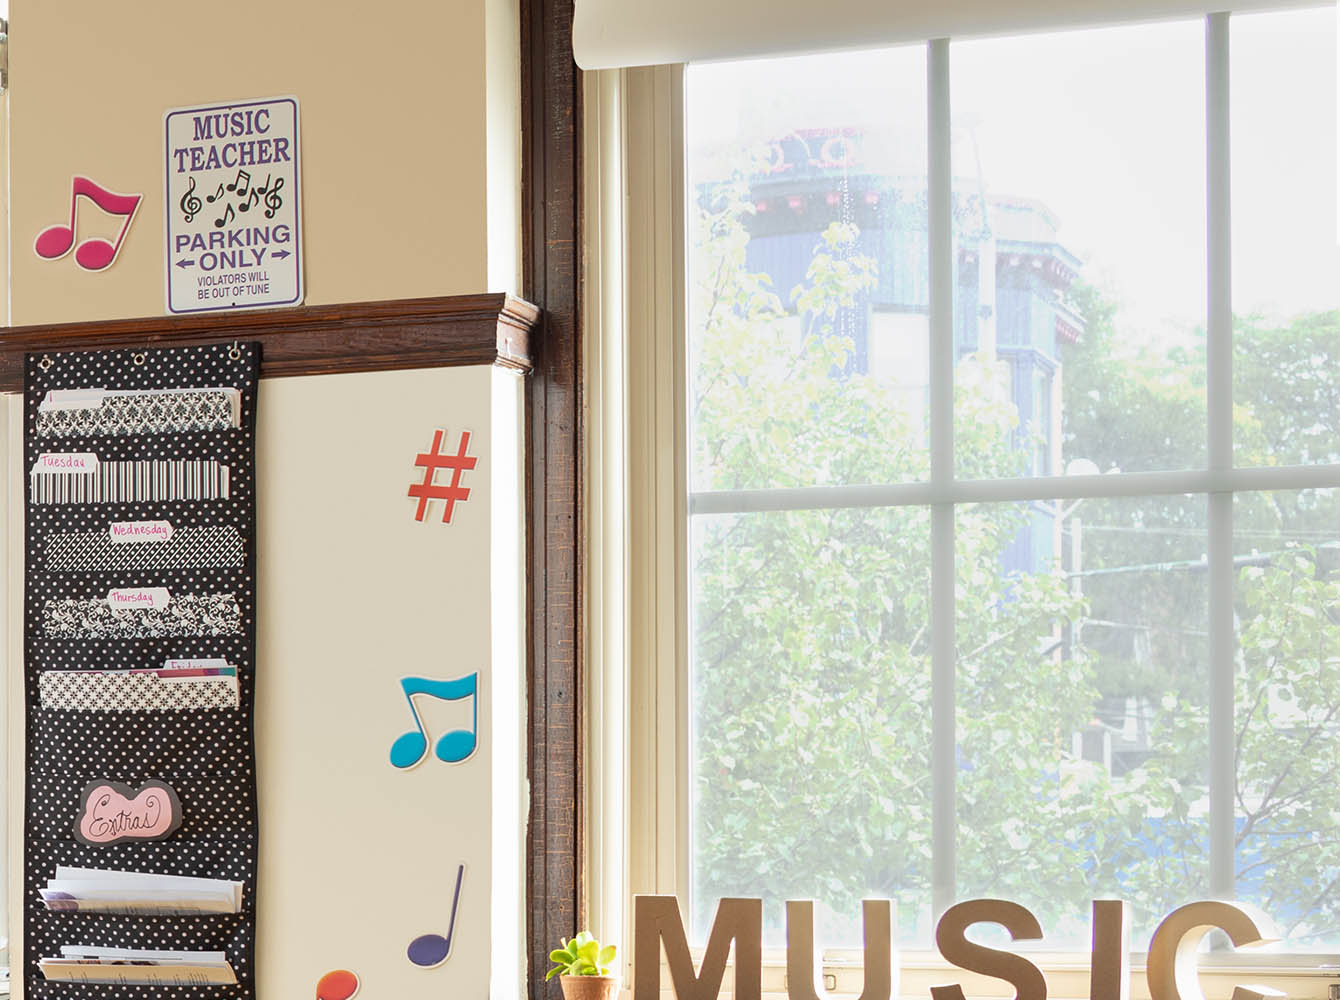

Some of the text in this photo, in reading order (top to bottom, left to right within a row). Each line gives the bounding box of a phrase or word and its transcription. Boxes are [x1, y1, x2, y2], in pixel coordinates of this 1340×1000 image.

[193, 109, 270, 141] MUSIC
[174, 137, 290, 173] TEACHER
[176, 225, 290, 252] PARKING
[200, 248, 267, 271] ONLY
[198, 271, 269, 287] VIOLATORS WILL
[198, 284, 269, 299] BE OUT OF TUNE
[41, 456, 84, 468] Tuesday
[113, 524, 167, 539] Wednesday
[112, 592, 153, 606] Thursday
[89, 794, 161, 836] Extras
